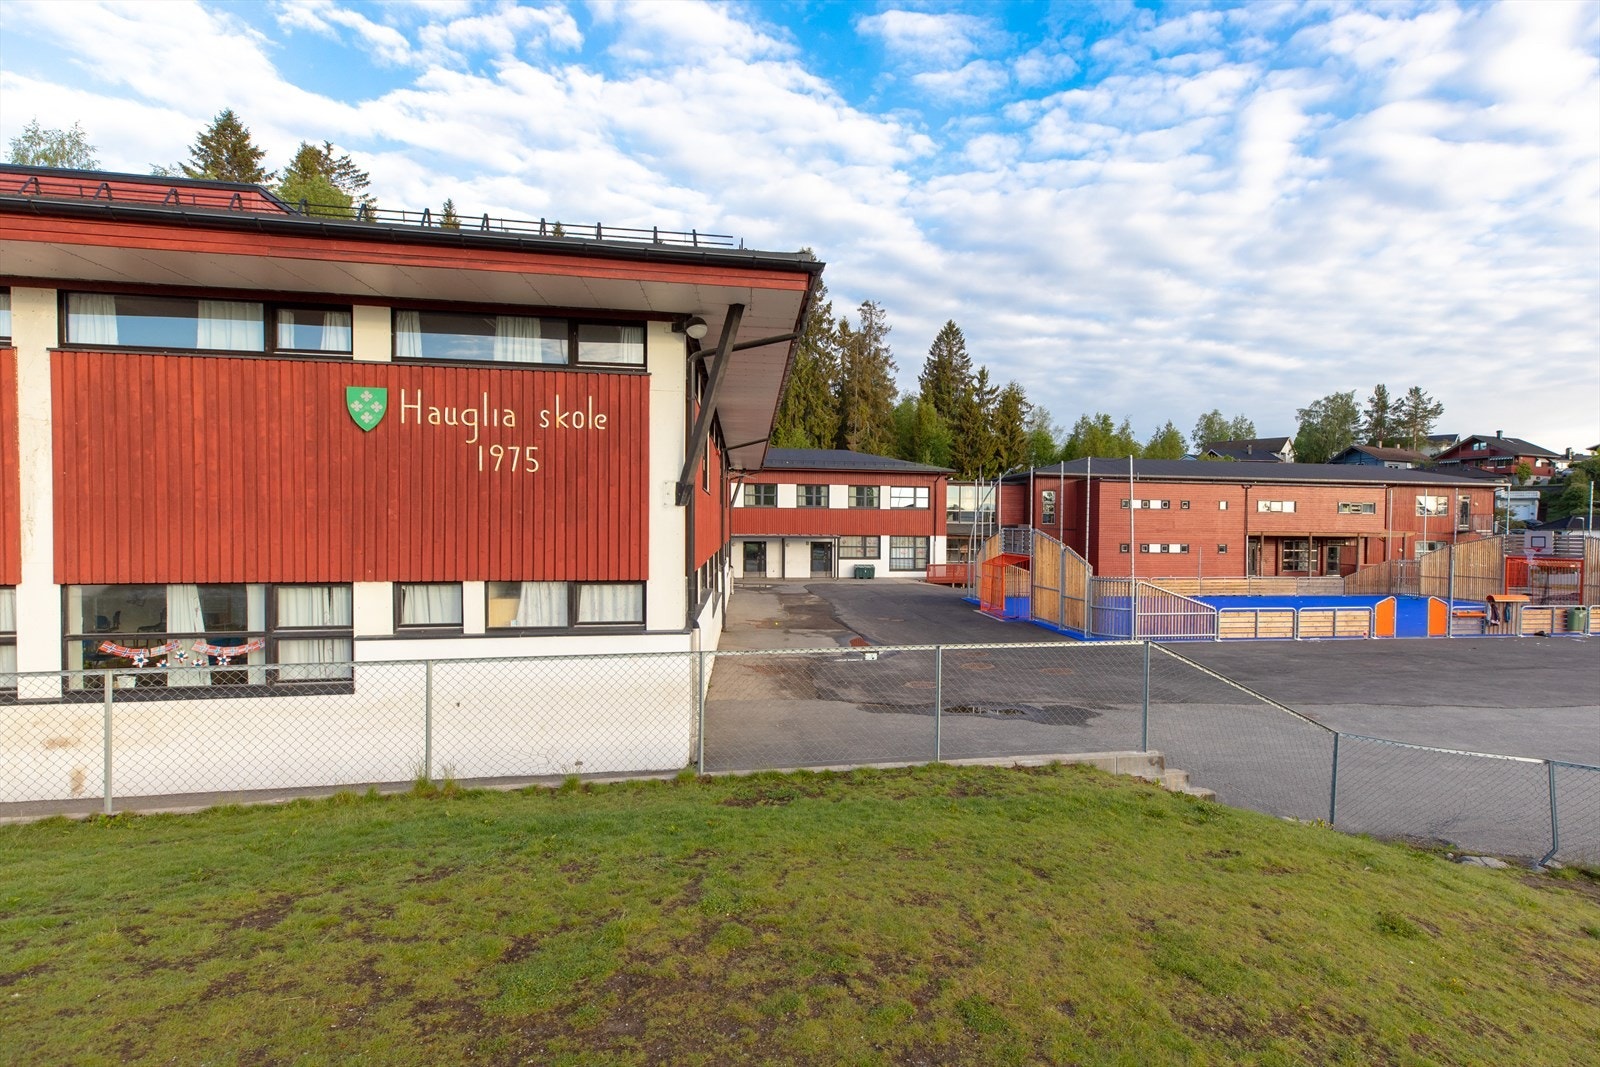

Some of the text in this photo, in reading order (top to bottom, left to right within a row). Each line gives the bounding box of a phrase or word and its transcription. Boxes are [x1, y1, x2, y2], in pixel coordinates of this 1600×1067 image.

[400, 388, 608, 444] Hauglia skole
[478, 444, 540, 473] 1975
